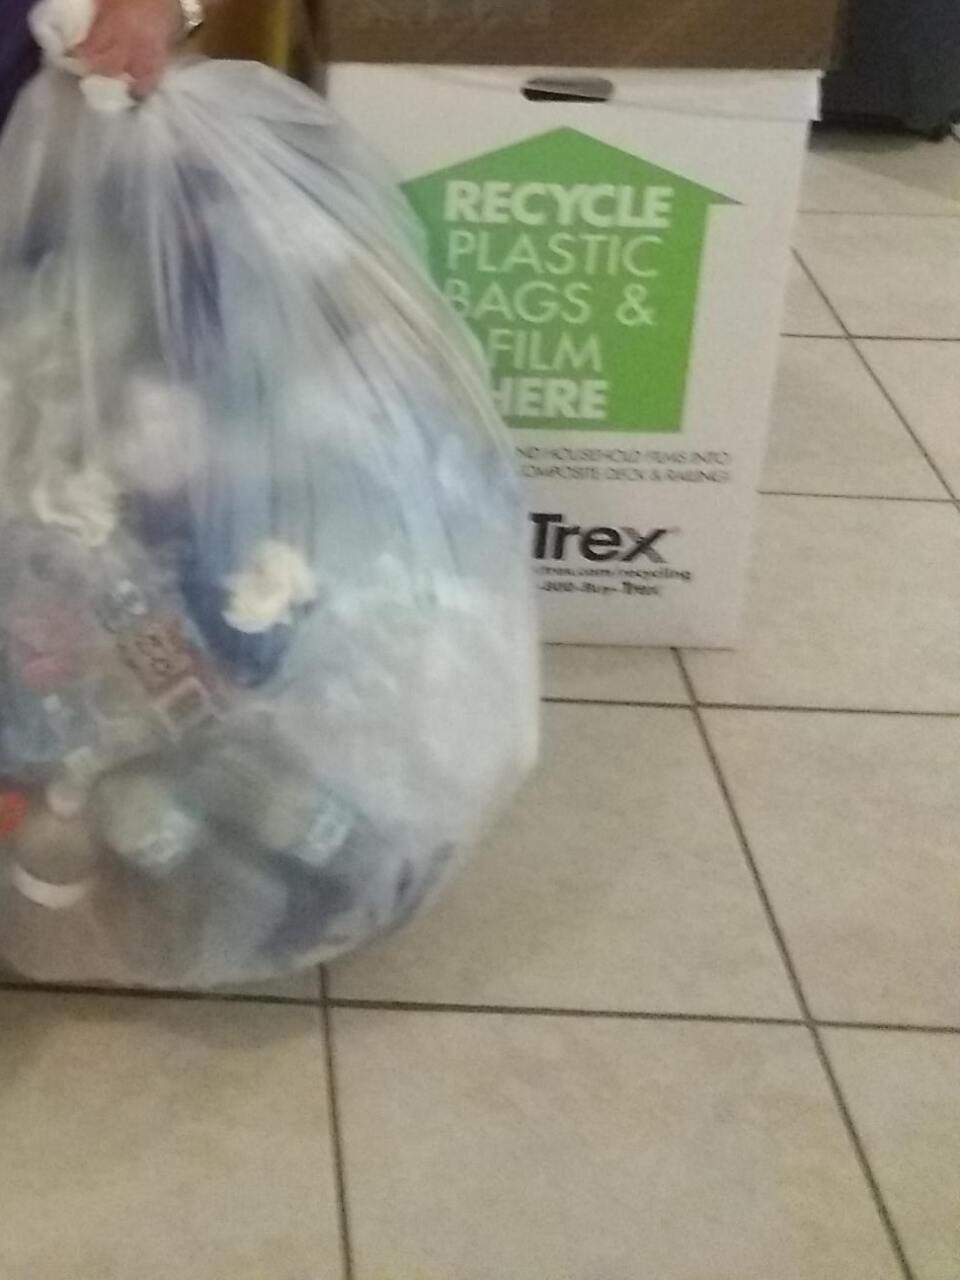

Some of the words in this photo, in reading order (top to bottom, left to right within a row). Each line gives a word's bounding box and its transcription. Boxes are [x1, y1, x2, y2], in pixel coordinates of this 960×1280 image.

[444, 180, 675, 229] RECYCLE
[446, 230, 664, 278] PLASTIC
[442, 278, 593, 324] BAGS
[616, 284, 658, 327] &
[487, 328, 604, 373] FILM
[491, 376, 610, 420] HERE
[529, 512, 670, 564] Trex
